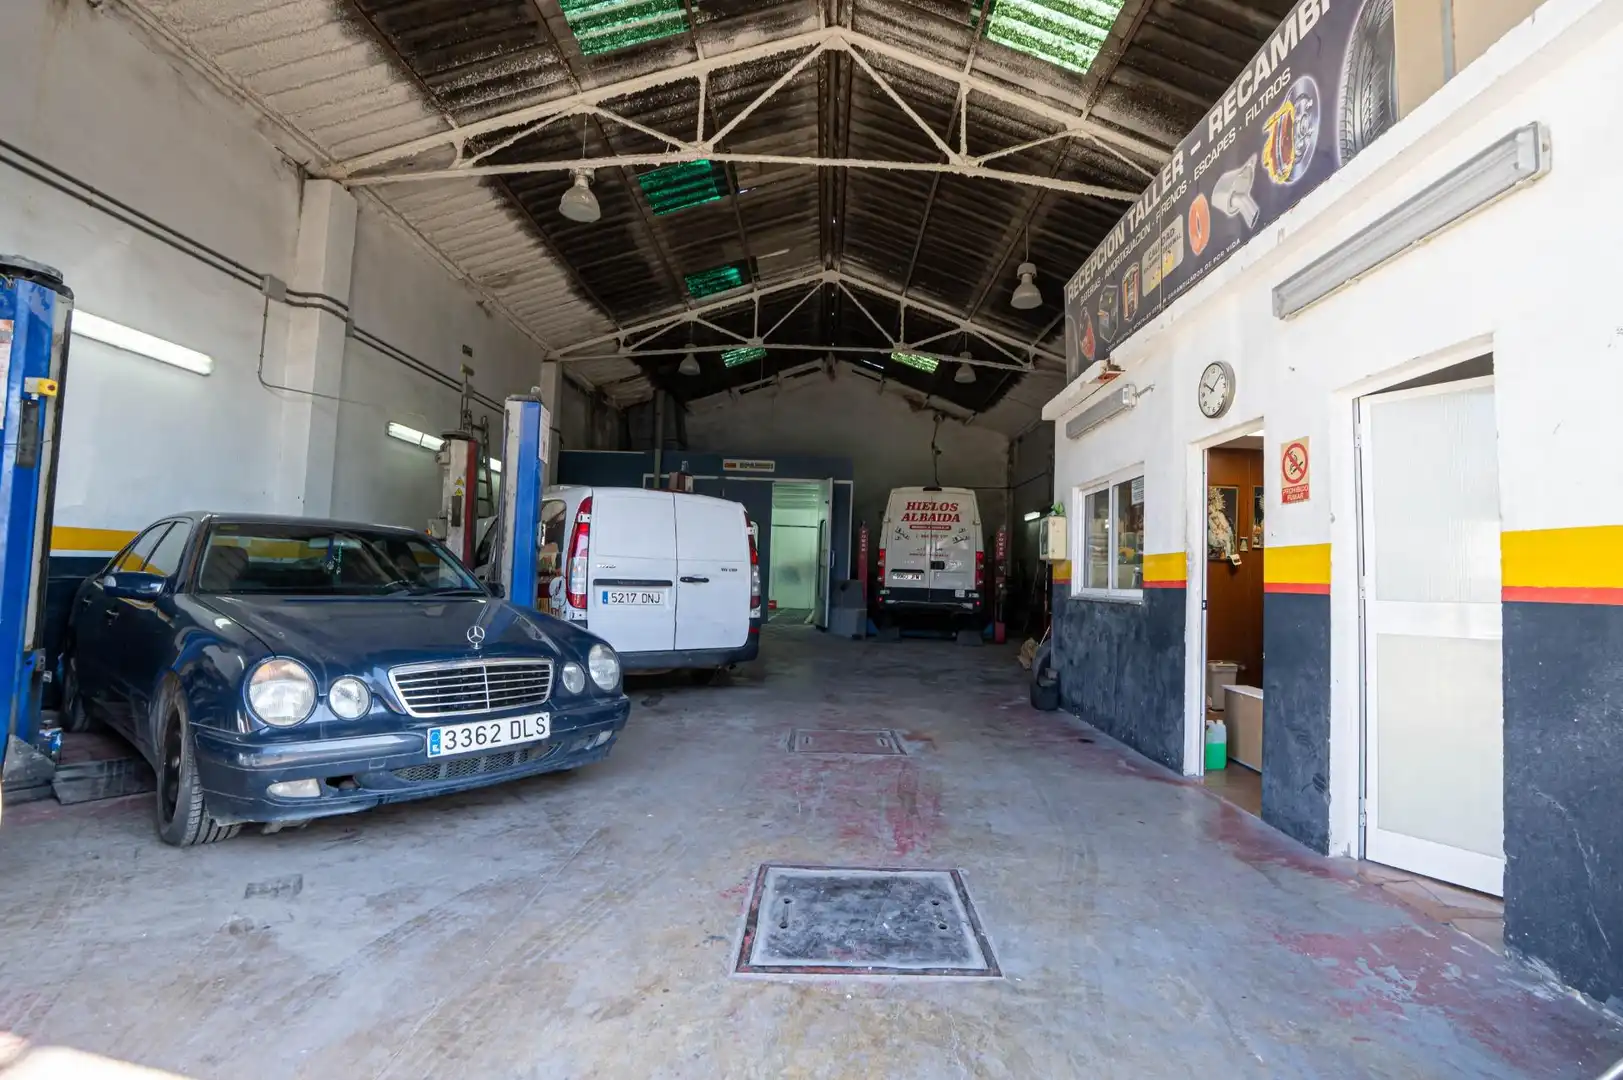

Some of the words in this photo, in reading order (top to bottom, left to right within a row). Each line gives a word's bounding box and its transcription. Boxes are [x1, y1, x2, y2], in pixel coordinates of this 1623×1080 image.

[1156, 181, 1188, 224] FRENOS
[1194, 127, 1236, 180] ESCAPES
[1245, 67, 1291, 126] FILTROS
[1067, 221, 1125, 304] RECEPCION
[1127, 150, 1184, 233] TALLER
[1213, 252, 1224, 264] POR
[1226, 238, 1240, 253] VIDA
[901, 513, 961, 522] ALBAIDA
[905, 501, 959, 512] HIELOS
[611, 592, 637, 604] 5217
[641, 592, 661, 604] DNJ
[444, 723, 502, 750] 3362
[510, 716, 546, 740] DLS
